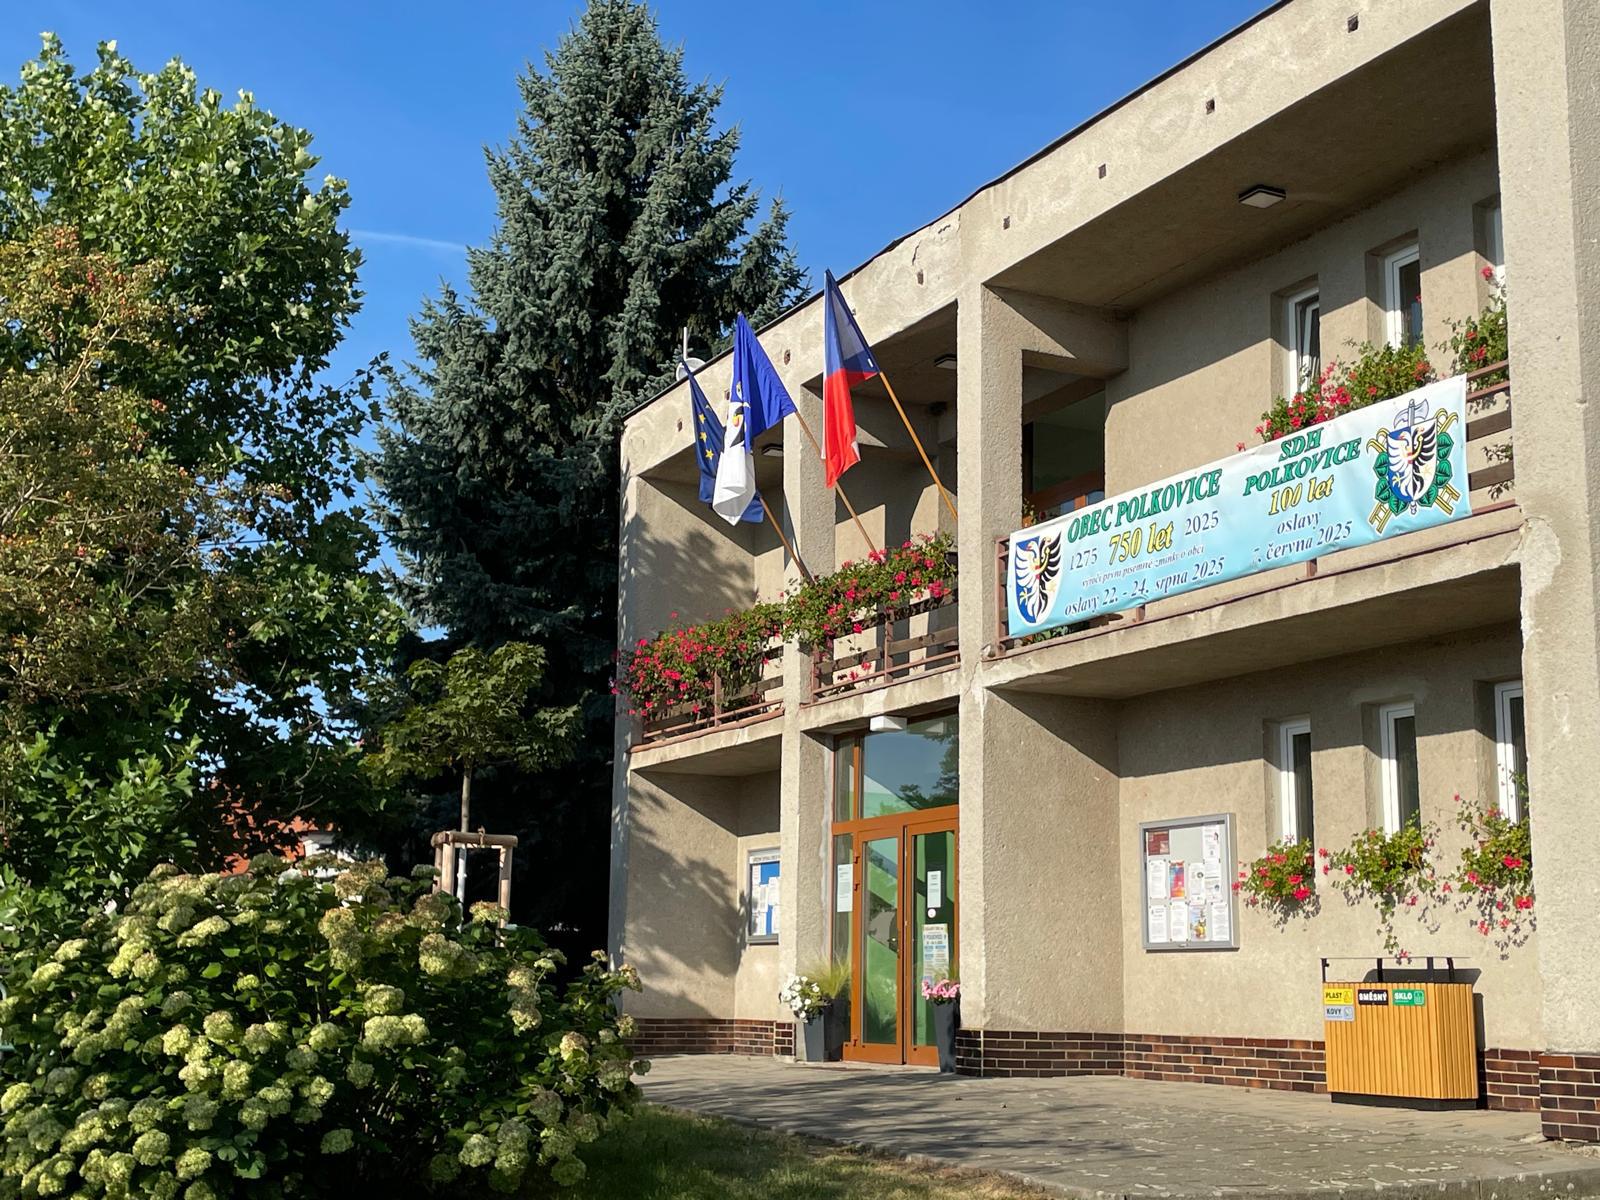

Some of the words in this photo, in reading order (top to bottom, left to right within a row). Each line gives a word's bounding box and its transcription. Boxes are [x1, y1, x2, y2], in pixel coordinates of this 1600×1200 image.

[1278, 427, 1324, 462] SDH
[1243, 437, 1362, 496] POLKOVICE
[1067, 504, 1114, 543] OBEC
[1115, 468, 1223, 528] POLKOVICE
[1268, 482, 1303, 516] 100
[1308, 474, 1335, 503] let
[1069, 548, 1098, 571] 1275
[1109, 528, 1143, 566] 750
[1147, 521, 1174, 554] let
[1184, 510, 1220, 536] 2025
[1266, 538, 1313, 562] června
[1317, 520, 1353, 547] 2025
[1277, 510, 1321, 536] oslavy
[1064, 594, 1100, 616] oslavy
[1102, 586, 1119, 606] 22.
[1131, 578, 1149, 597] 24.
[1154, 570, 1188, 593] srpna
[1191, 557, 1225, 581] 2025
[1394, 992, 1412, 1000] SKLO
